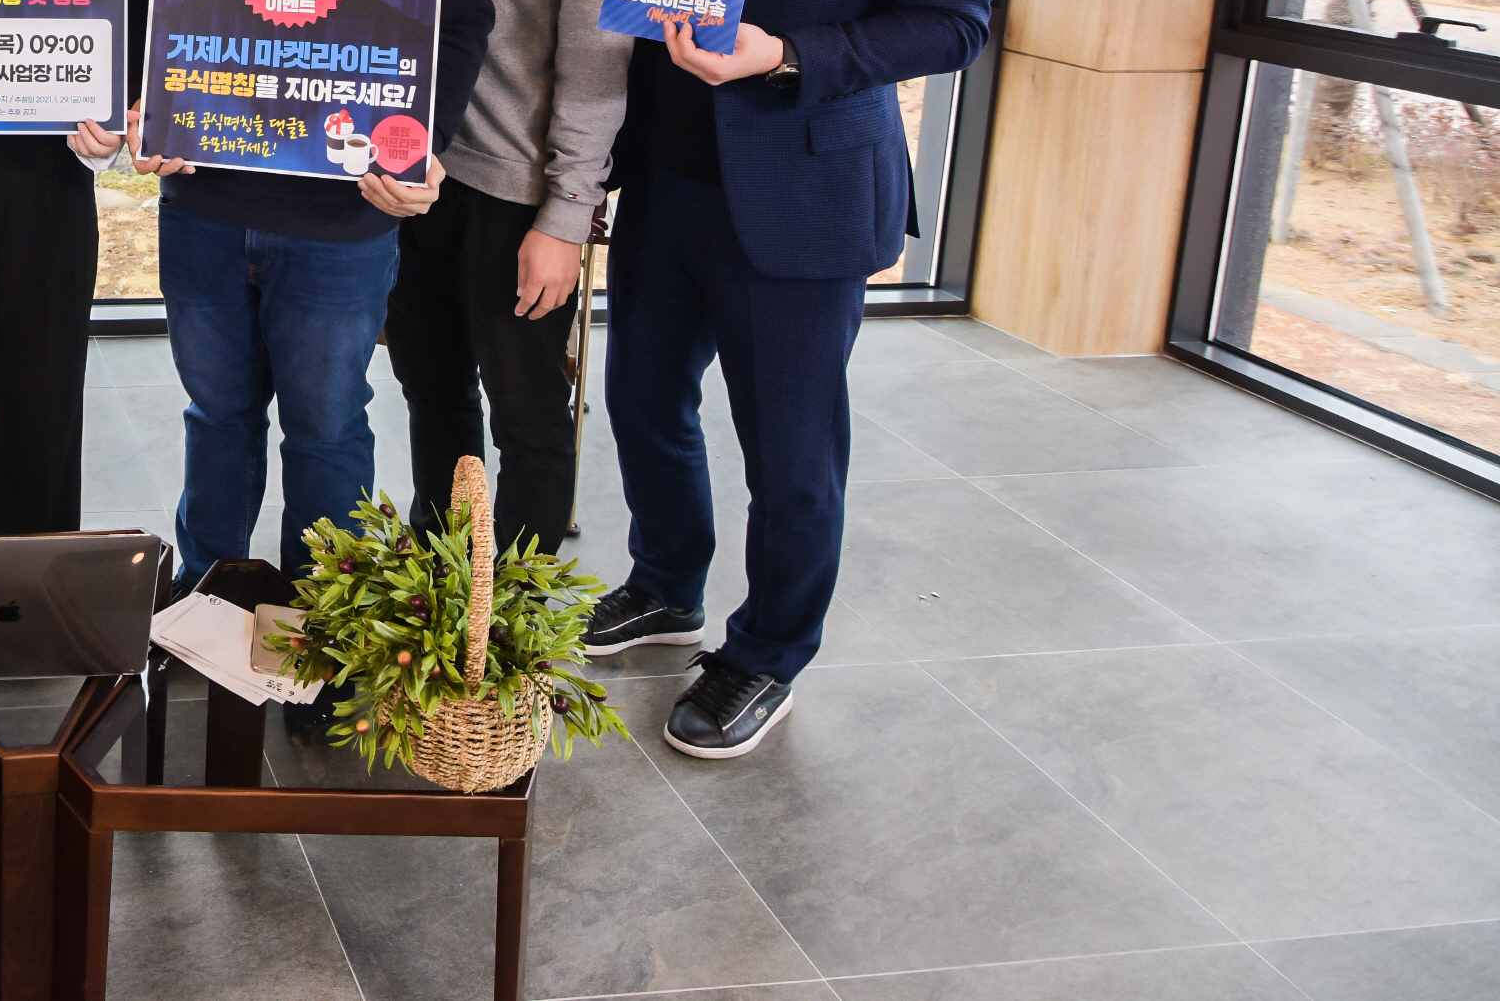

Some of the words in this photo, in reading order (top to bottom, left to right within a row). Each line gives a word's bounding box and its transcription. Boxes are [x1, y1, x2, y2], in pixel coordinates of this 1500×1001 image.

[646, 7, 694, 24] Market
[697, 10, 725, 27] Live
[29, 34, 94, 54] 09:00
[167, 34, 249, 66] 거제시
[254, 39, 416, 77] 마켓라이브의
[56, 64, 92, 83] 대상
[164, 68, 279, 99] 공식명칭을
[284, 77, 416, 109] 지어주세요!
[173, 112, 196, 129] 지금
[200, 112, 264, 137] 공식명칭을
[269, 118, 308, 139] 댓글로
[199, 135, 277, 157] 응모해주세요!
[388, 148, 409, 161] 10명
